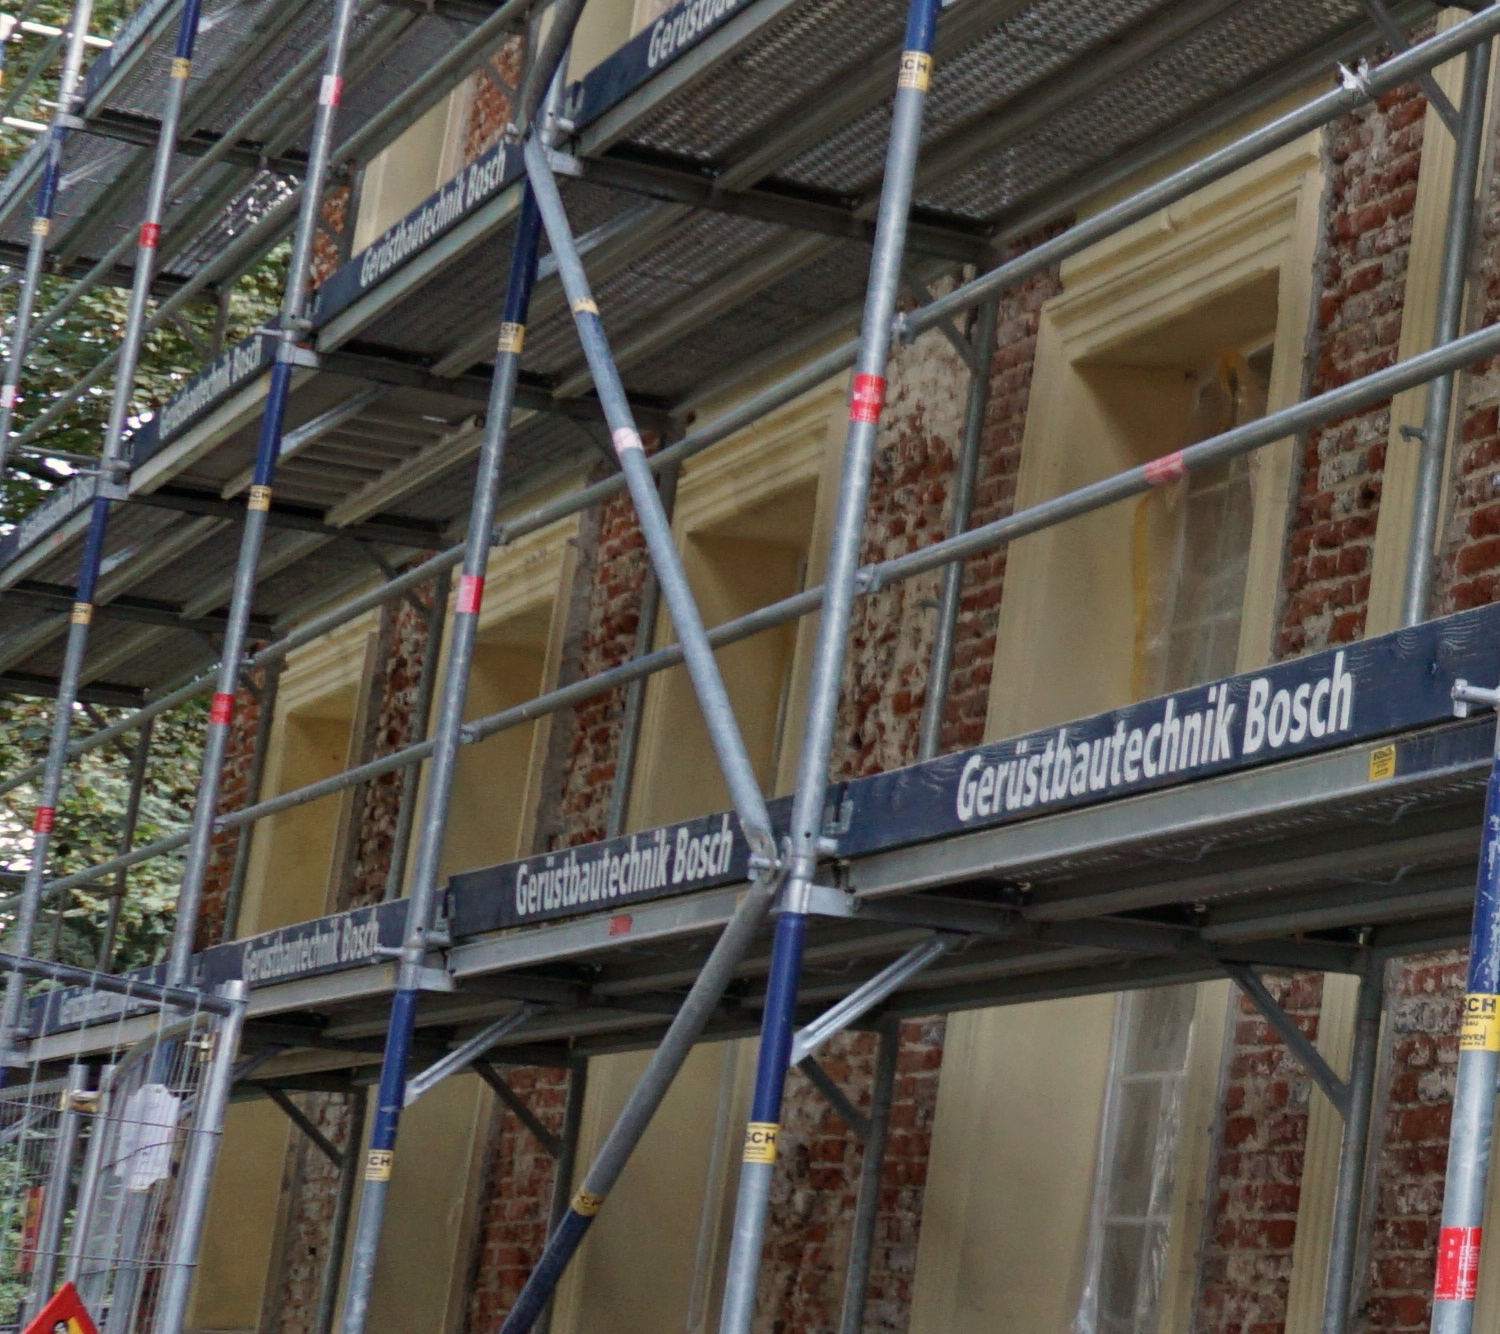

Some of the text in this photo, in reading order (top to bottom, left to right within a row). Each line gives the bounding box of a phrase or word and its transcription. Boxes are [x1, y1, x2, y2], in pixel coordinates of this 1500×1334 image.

[466, 139, 506, 208] Bosch
[956, 651, 1352, 823] Gerüstbautechnik Bosch
[516, 814, 734, 916] Gerüstbautechnik Bosch
[341, 907, 380, 962] Bosch
